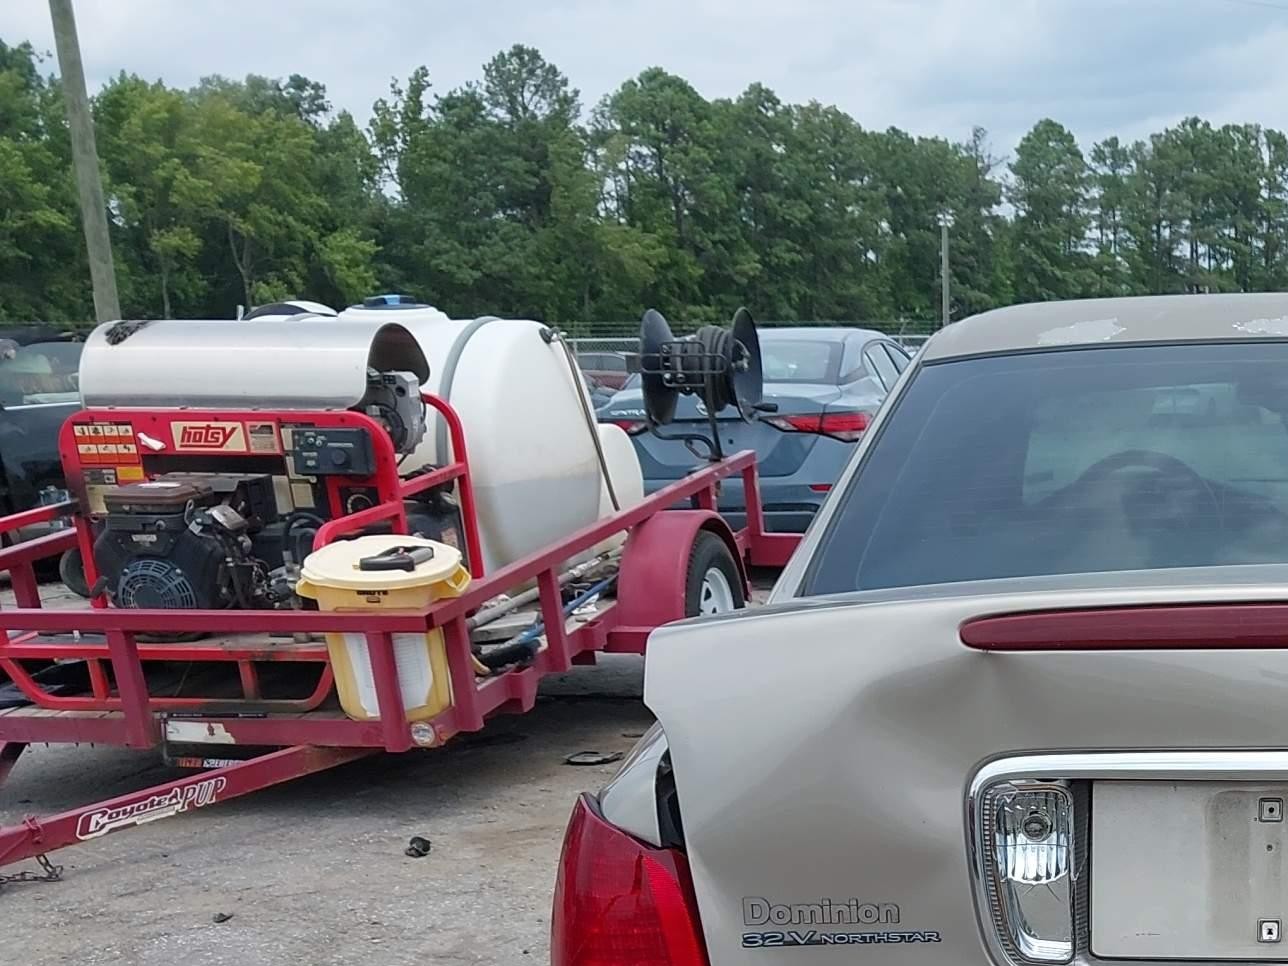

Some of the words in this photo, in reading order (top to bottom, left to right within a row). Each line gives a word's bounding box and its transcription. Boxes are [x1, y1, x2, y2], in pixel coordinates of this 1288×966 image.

[179, 424, 238, 449] hotsy
[178, 778, 226, 812] PUP
[742, 896, 900, 926] Dominion
[820, 931, 941, 945] NORTHSTAR
